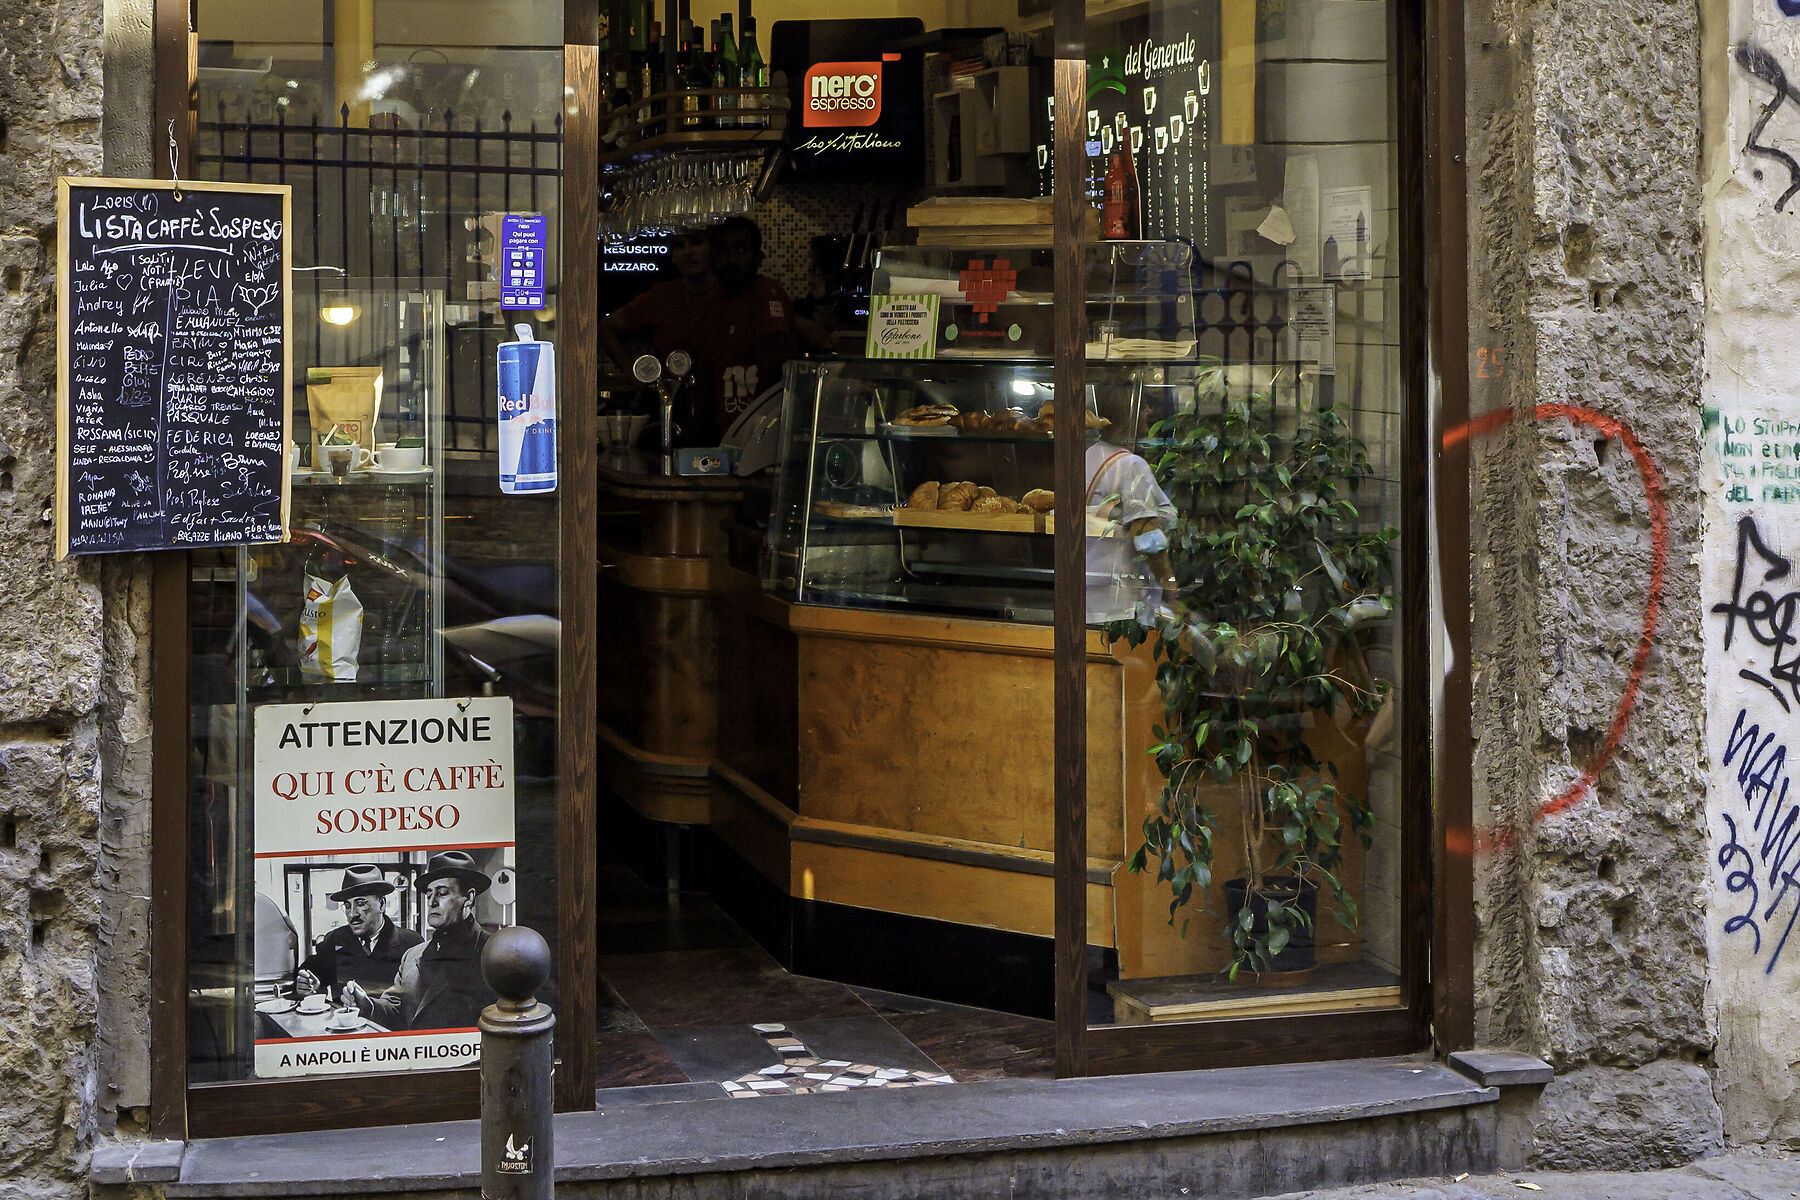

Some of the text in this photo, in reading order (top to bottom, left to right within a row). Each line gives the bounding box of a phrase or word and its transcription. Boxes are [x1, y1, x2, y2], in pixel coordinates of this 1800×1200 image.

[1125, 32, 1196, 80] del Generale
[811, 74, 875, 98] nero
[810, 97, 876, 113] espresso
[80, 202, 143, 241] LISTA
[209, 207, 283, 241] SOSPESO
[603, 262, 659, 271] LAZZARO.
[1475, 346, 1505, 379] 25
[499, 393, 527, 412] Red
[278, 716, 491, 750] ATTENZIONE
[271, 770, 335, 801] QUI
[403, 758, 505, 793] CAFFÈ
[316, 803, 461, 835] SOSPESO
[279, 1042, 480, 1068] A NAPOLI È UNA FILOSOF
